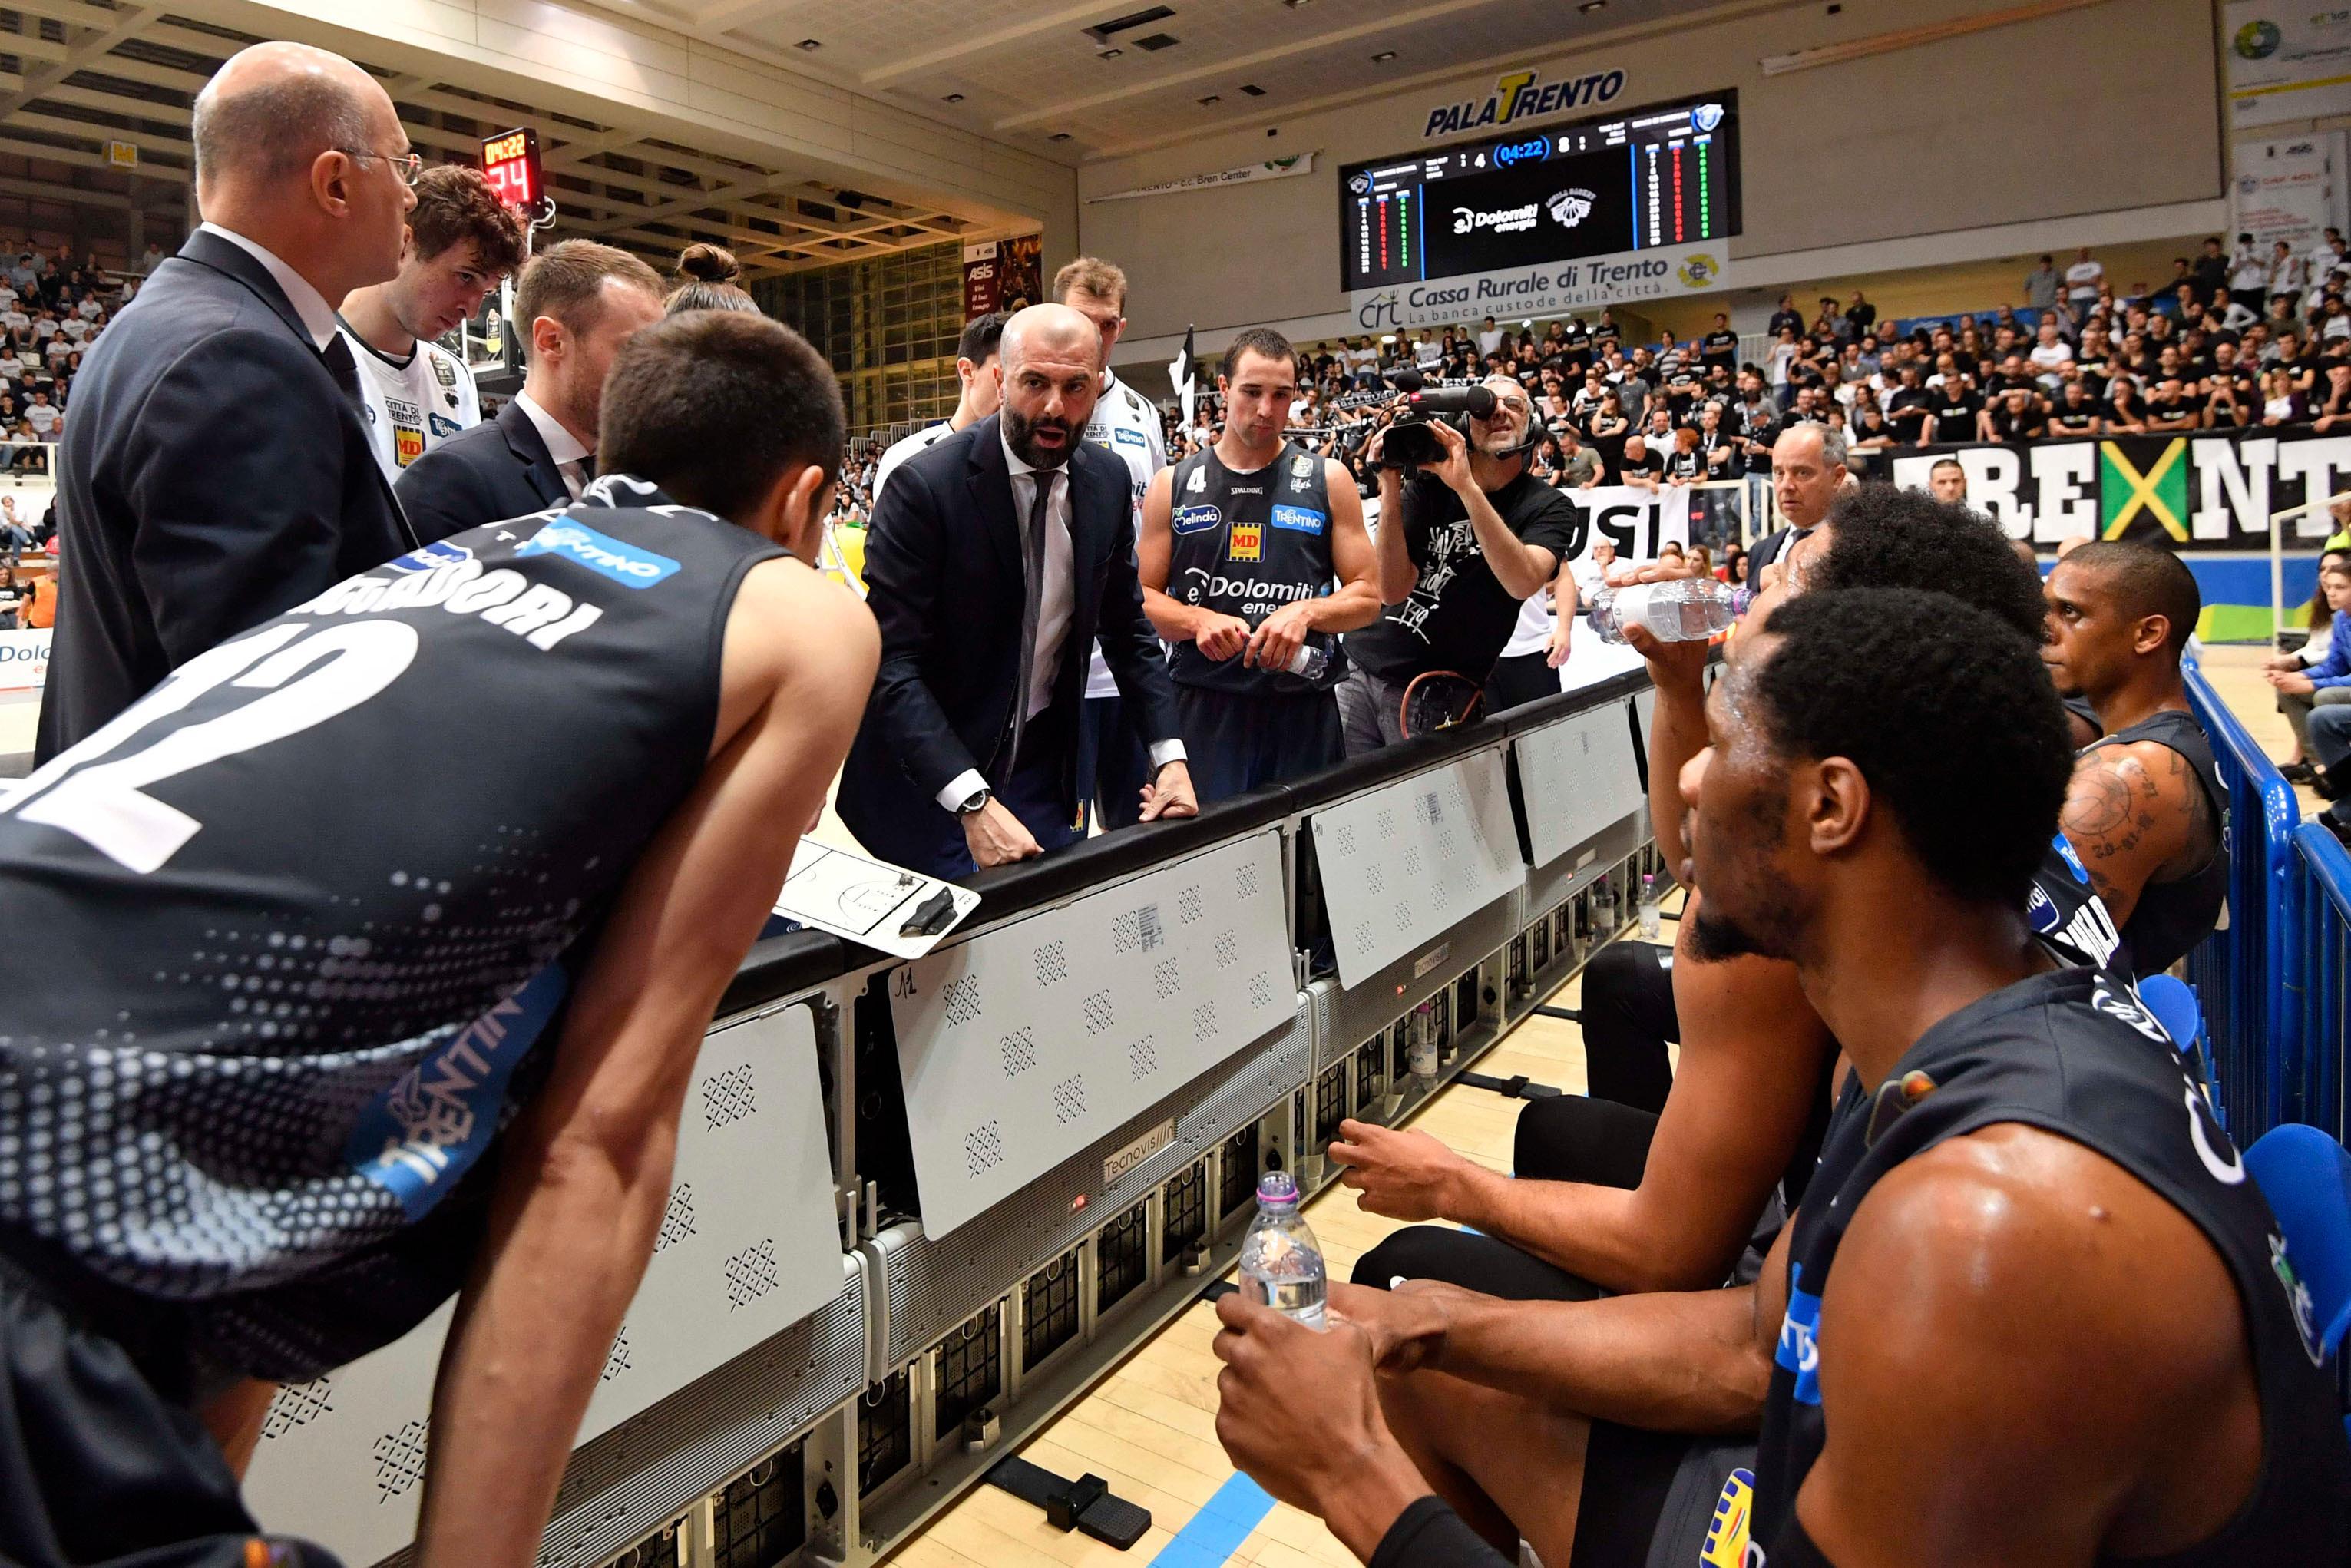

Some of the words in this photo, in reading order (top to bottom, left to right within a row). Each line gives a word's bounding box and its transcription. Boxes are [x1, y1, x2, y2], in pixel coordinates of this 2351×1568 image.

[1425, 71, 1623, 137] PALATRENTO
[485, 134, 525, 165] 04:22
[1474, 153, 1486, 167] 4
[1500, 141, 1543, 162] 04:22
[1197, 174, 1218, 185] Bren
[1221, 170, 1252, 181] Center
[1474, 203, 1539, 227] Dolomiti
[1494, 218, 1537, 233] energia
[1409, 287, 1470, 308] Cassa
[1477, 271, 1549, 299] Rurale
[1557, 266, 1578, 288] di
[1586, 260, 1668, 285] Trento
[1409, 313, 1425, 324] La
[1432, 308, 1479, 322] banca
[1486, 295, 1556, 313] custode
[1563, 289, 1609, 304] della
[1186, 465, 1207, 493] 4
[1230, 486, 1264, 495] SPALDING
[1174, 511, 1218, 528] Melinda
[1275, 509, 1321, 528] TRENTINO
[1232, 534, 1258, 548] MD
[1209, 576, 1313, 601] Dolomiti
